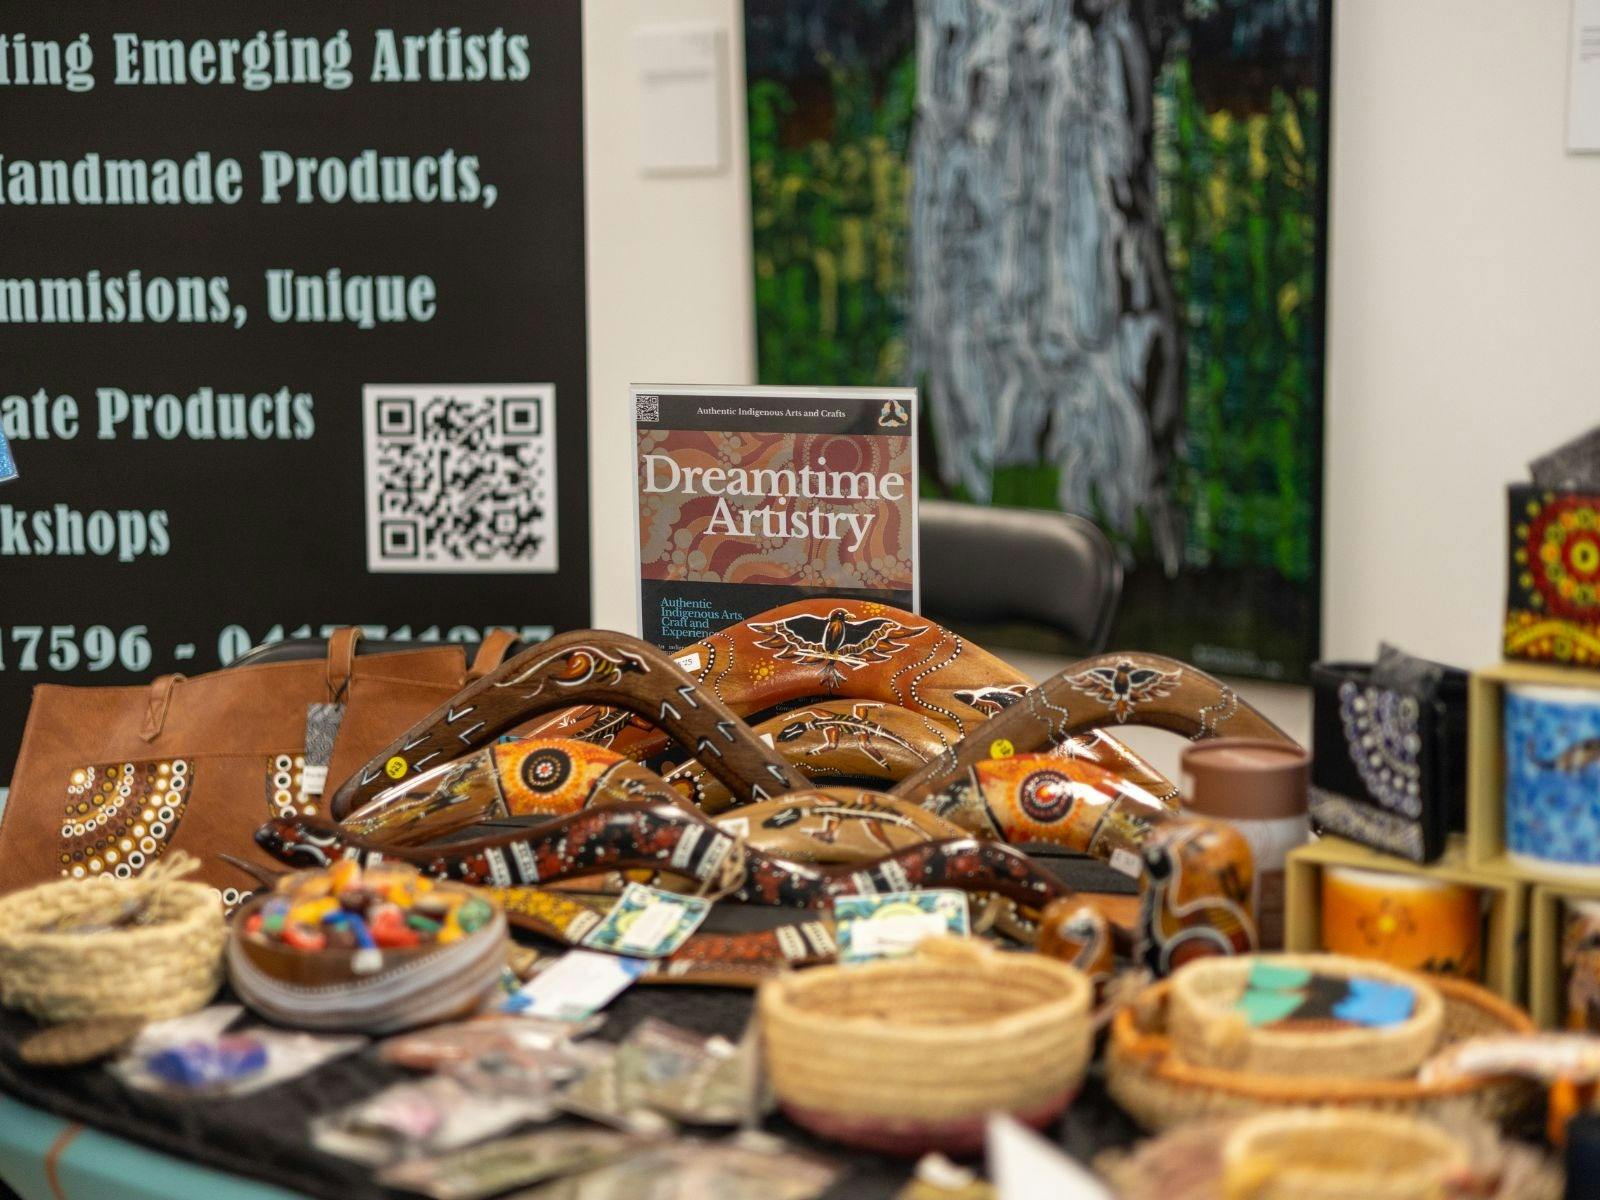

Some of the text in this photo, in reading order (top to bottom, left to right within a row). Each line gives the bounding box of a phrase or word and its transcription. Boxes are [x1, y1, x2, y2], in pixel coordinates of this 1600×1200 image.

[113, 29, 354, 91] Emerging
[370, 26, 531, 82] Artists
[0, 148, 498, 208] andmade Products,
[0, 268, 436, 329] mmisions, Unique
[96, 386, 315, 440] Products
[697, 407, 846, 418] Authentic Indigenous Arts and Crafts
[642, 454, 905, 500] Dreamtime
[703, 497, 876, 552] Artistry
[660, 597, 713, 609] Authentic
[661, 607, 719, 620] Indigenous
[661, 616, 709, 628] Craft and
[0, 624, 152, 671] 7596
